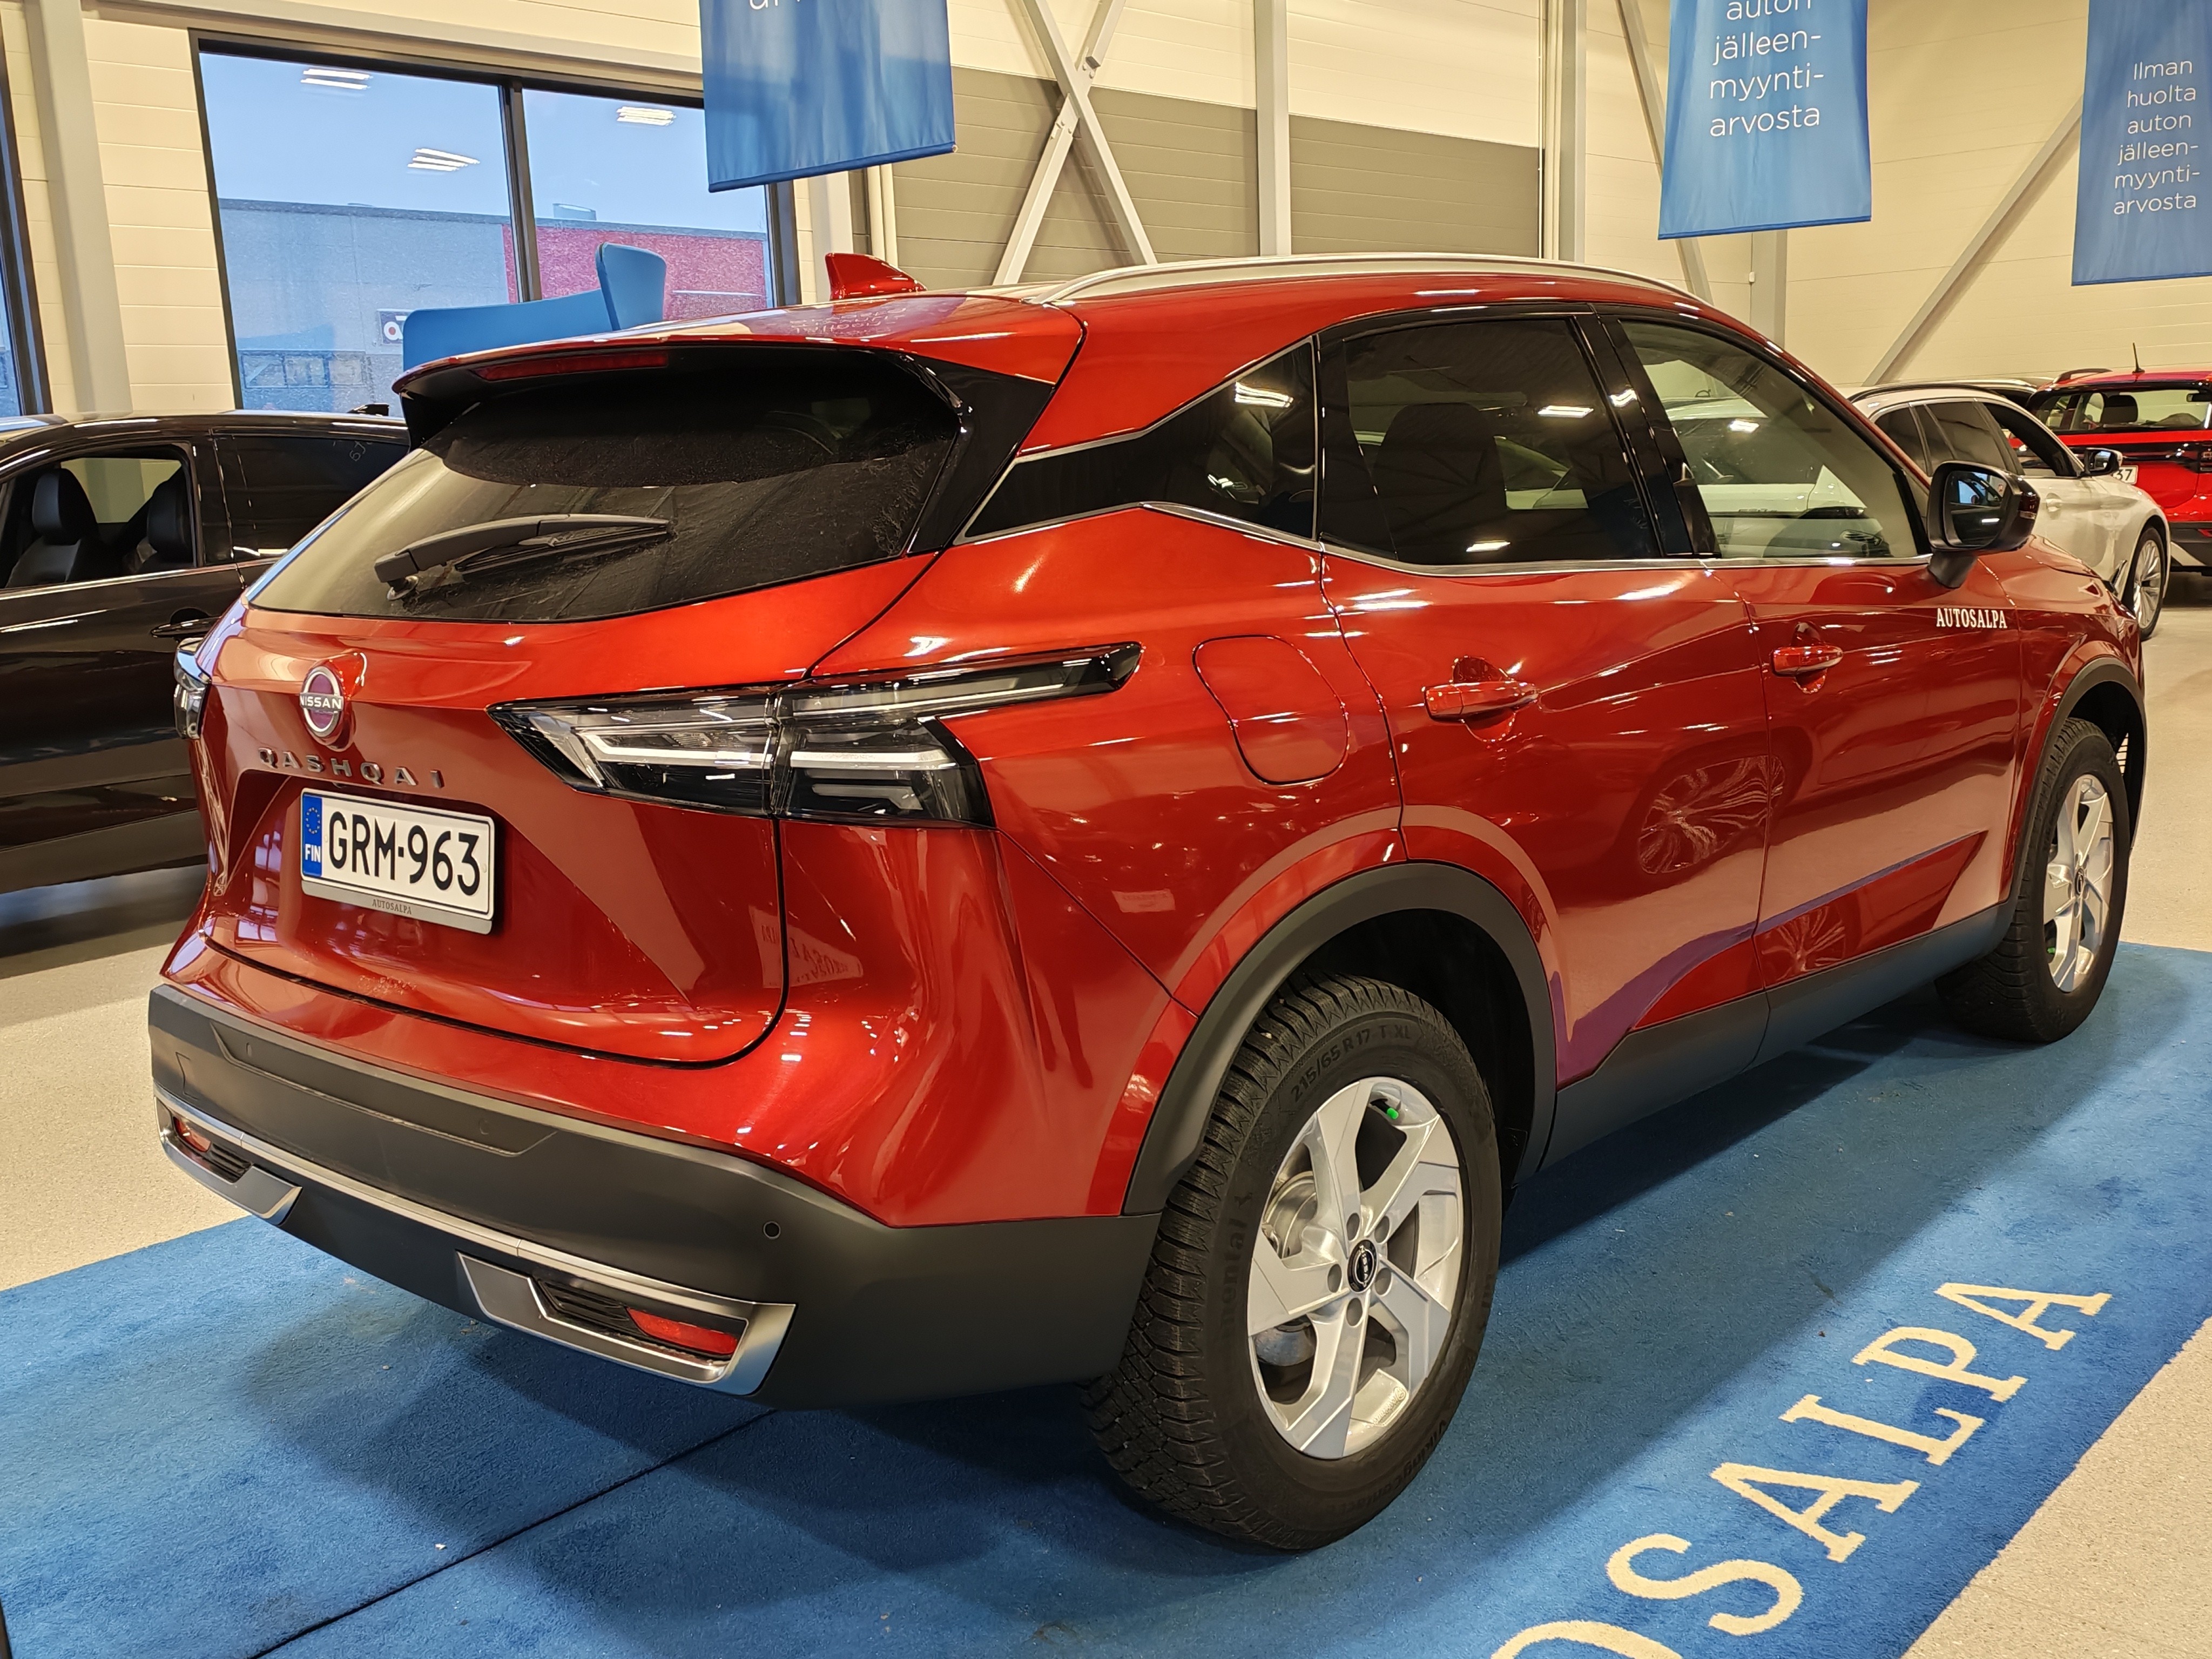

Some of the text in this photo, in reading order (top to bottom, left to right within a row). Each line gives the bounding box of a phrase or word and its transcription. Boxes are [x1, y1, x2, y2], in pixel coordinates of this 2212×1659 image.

[1712, 30, 1822, 65] jälleen-
[1710, 62, 1824, 101] myynti-
[2134, 60, 2193, 80] Ilman
[2127, 84, 2196, 108] huolta
[1710, 104, 1820, 137] arvosta
[2127, 114, 2191, 134] auton
[2117, 141, 2198, 166] jälleen-
[2114, 164, 2200, 190] myynti-
[2113, 192, 2196, 215] arvosta
[1936, 608, 2008, 629] AUTOSALPA
[300, 695, 341, 709] NISSAN
[258, 747, 444, 789] QASHQAI
[305, 843, 321, 864] FIN
[328, 811, 480, 896] GRM-963
[372, 899, 412, 915] AUTOSALPA
